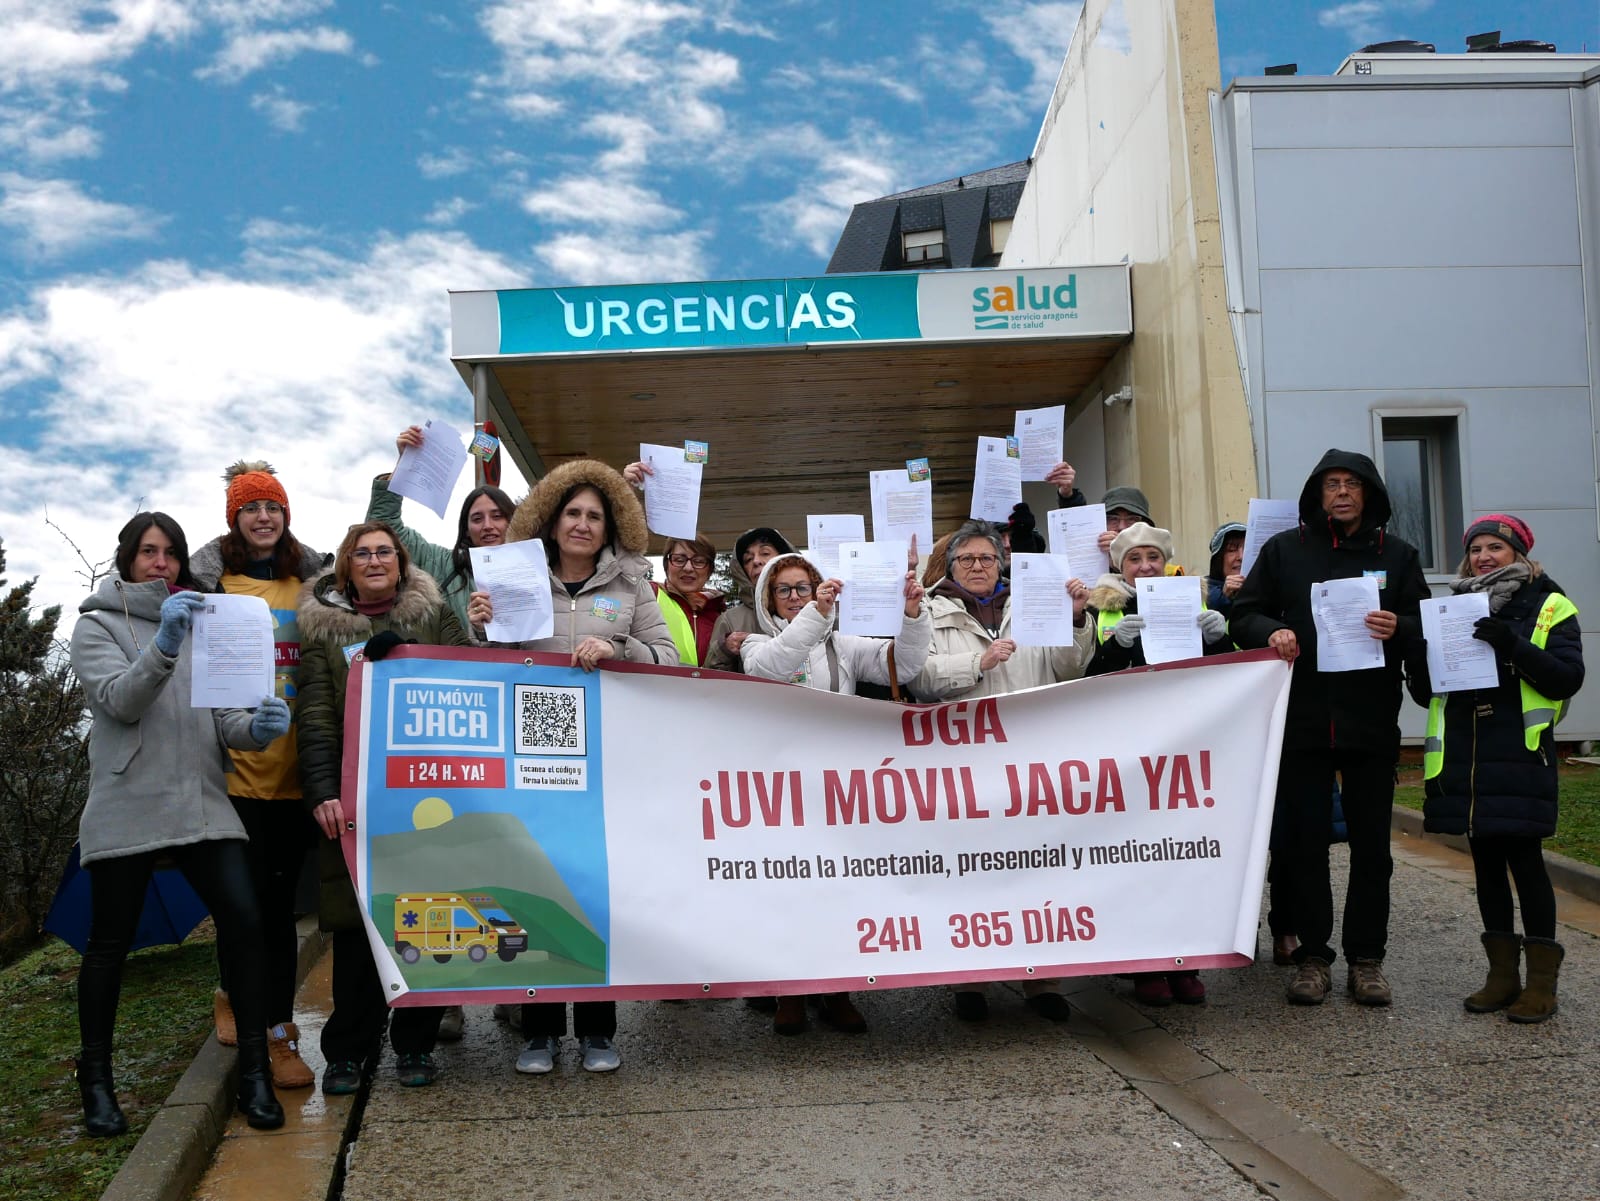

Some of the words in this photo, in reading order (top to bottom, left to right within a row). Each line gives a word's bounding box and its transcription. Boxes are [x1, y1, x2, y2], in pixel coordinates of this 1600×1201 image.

[973, 274, 1077, 312] salud
[563, 291, 857, 337] URGENCIAS
[1011, 313, 1041, 321] servicio
[1043, 311, 1078, 321] aragonés
[1023, 320, 1044, 329] salud
[406, 689, 434, 705] UVI
[438, 688, 487, 708] MÓVIL
[404, 708, 488, 739] JACA
[902, 698, 1008, 747] DGA
[419, 762, 437, 781] 24
[442, 764, 457, 781] H.
[461, 763, 485, 781] YA!
[520, 765, 546, 773] Escanea
[548, 765, 555, 773] el
[556, 766, 576, 775] código
[699, 770, 805, 840] ¡UVI
[823, 757, 990, 824] MÓVIL
[1004, 758, 1126, 818] JACA
[1139, 750, 1215, 811] YA!
[707, 857, 757, 880] Para
[762, 855, 811, 880] toda
[816, 855, 836, 878] la
[842, 850, 951, 878] Jacetania,
[957, 843, 1067, 877] presencial
[1072, 847, 1083, 870] y
[1089, 836, 1222, 865] medicalizada
[857, 916, 922, 954] 24H
[948, 911, 1013, 949] 365
[1022, 900, 1096, 944] DÍAS
